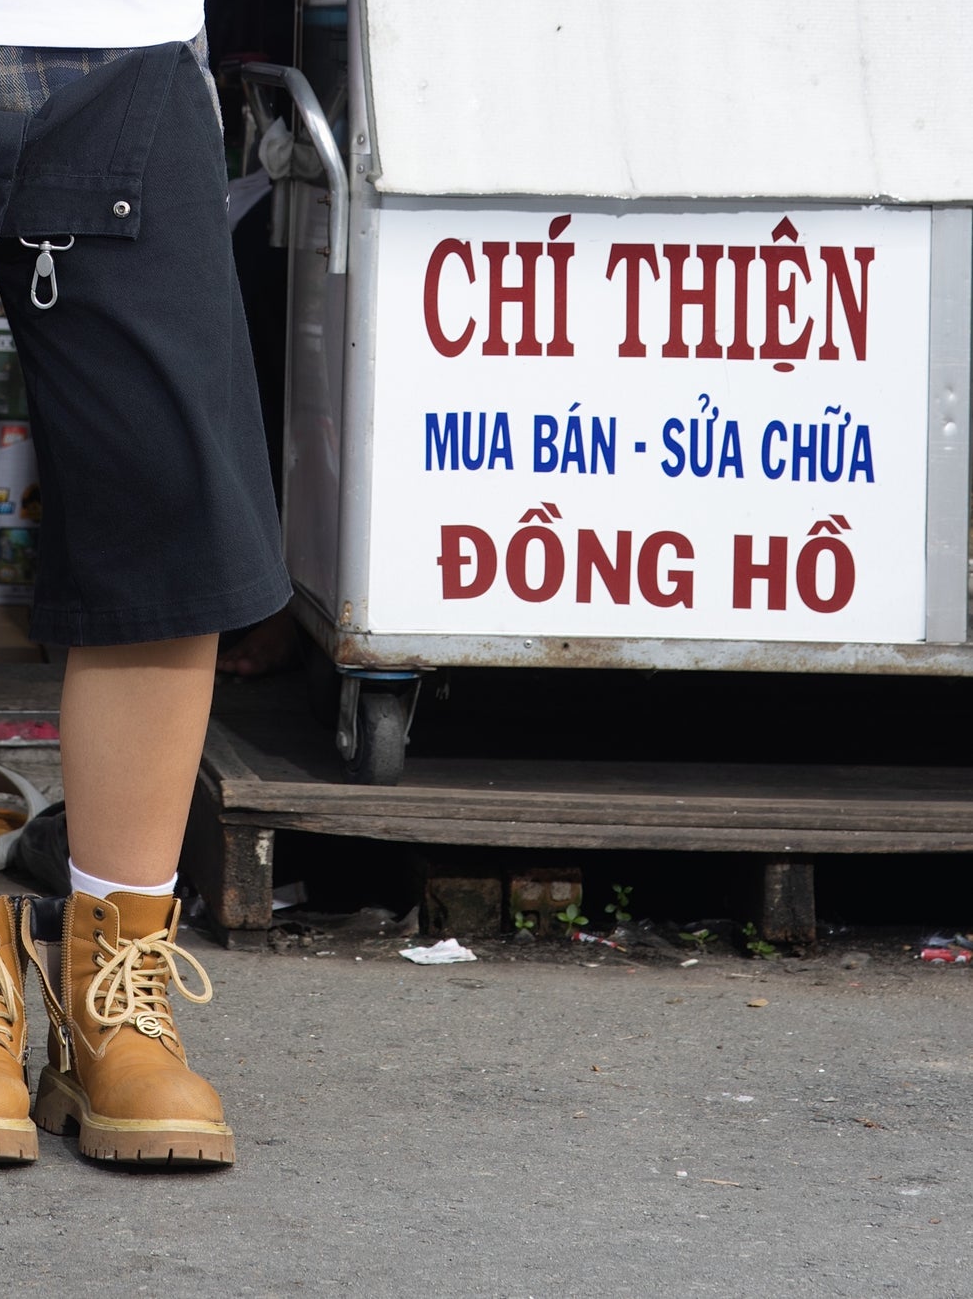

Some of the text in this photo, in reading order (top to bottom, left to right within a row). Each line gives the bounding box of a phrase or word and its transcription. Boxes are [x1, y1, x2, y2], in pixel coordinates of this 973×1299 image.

[423, 213, 876, 373] CHÍ THIỆN
[424, 410, 515, 471] MUA
[532, 401, 617, 475] BÁN
[660, 393, 745, 480] SỬA
[760, 405, 876, 484] CHỮA
[437, 502, 856, 614] ĐỒNG HỒ
